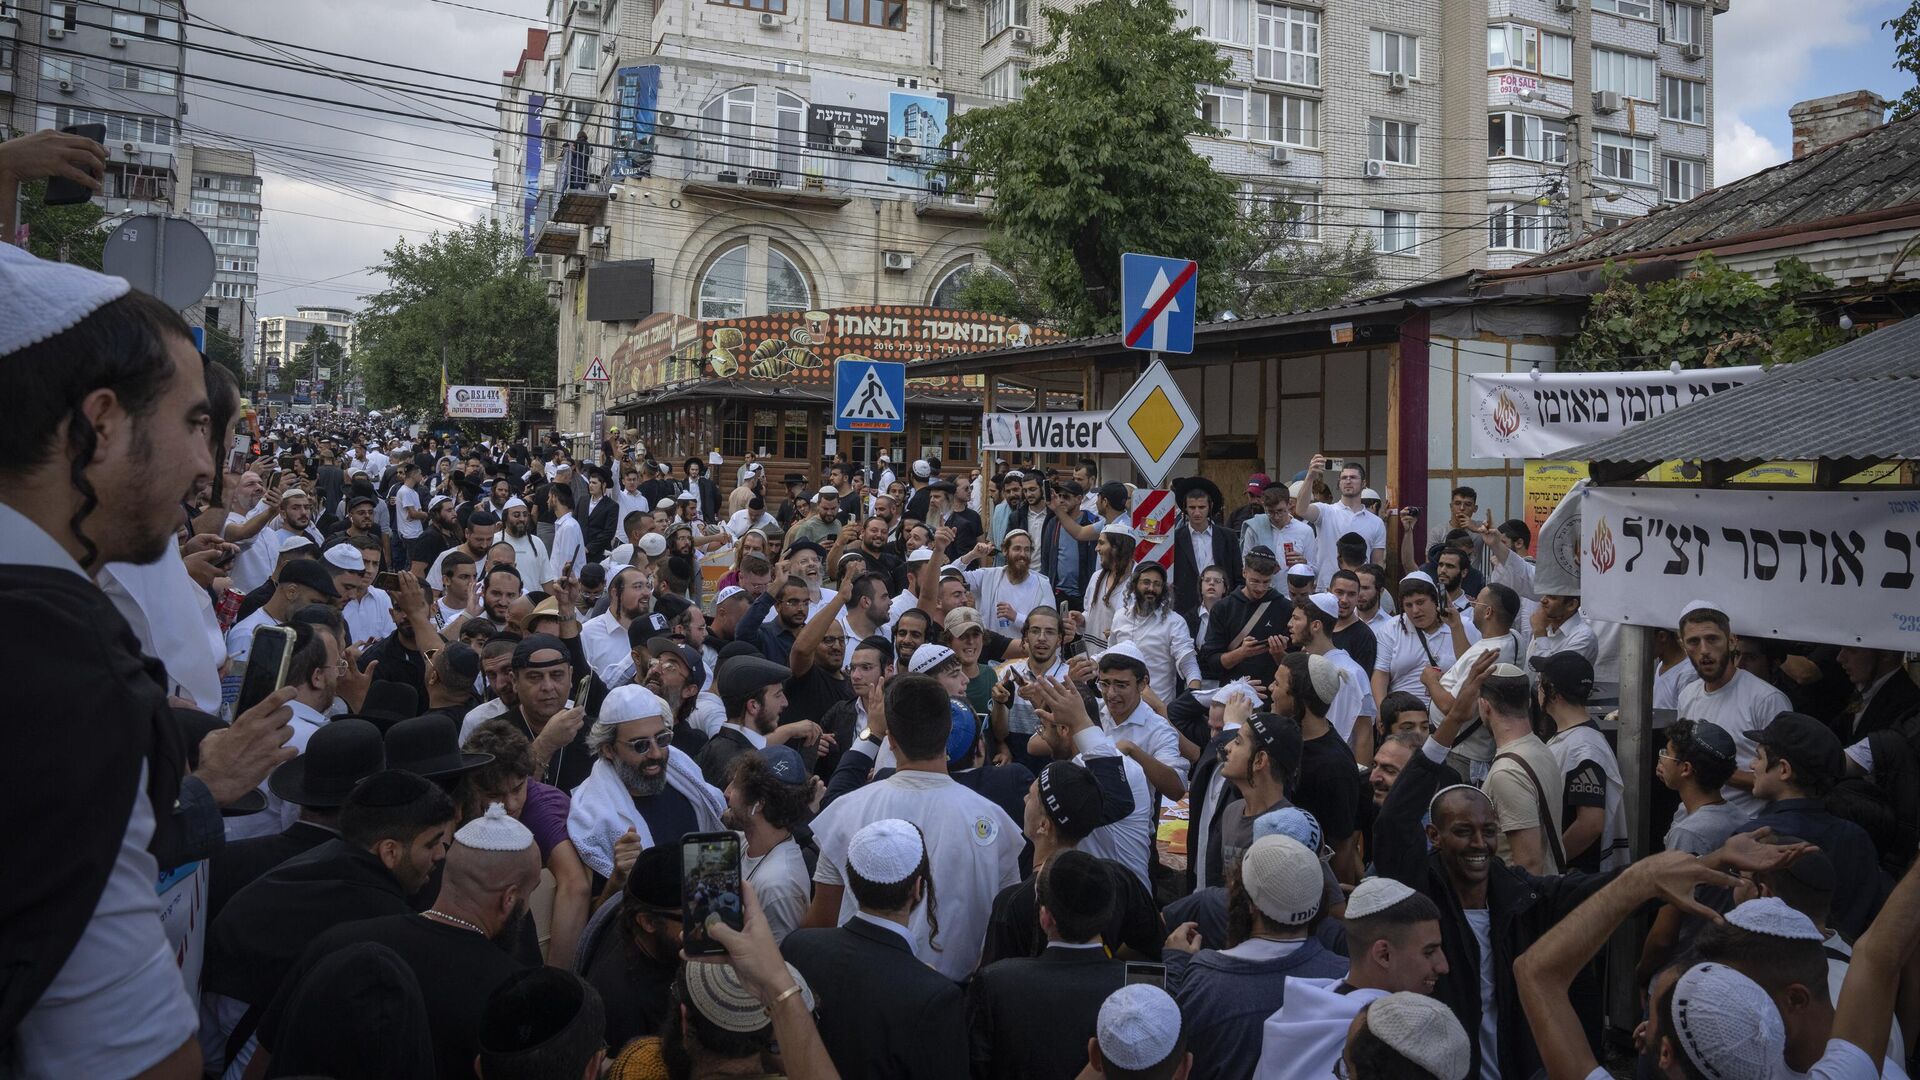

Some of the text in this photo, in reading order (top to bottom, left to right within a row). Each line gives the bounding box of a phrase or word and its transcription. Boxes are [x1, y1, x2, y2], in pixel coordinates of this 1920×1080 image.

[1500, 76, 1536, 89] FOR SALE
[815, 108, 886, 126] ישוב הדעת
[833, 313, 1004, 344] המאפה הנאמן
[873, 342, 894, 351] 2016
[898, 344, 932, 353] בשנת
[486, 389, 500, 400] 4X4
[1533, 387, 1609, 427] מאומן
[1615, 384, 1678, 426] נחמן
[1027, 416, 1103, 448] Water
[1529, 492, 1551, 503] צדקה
[1887, 500, 1920, 514] אומן
[1623, 515, 1920, 590] ב אודסר זצ״ל
[1569, 783, 1605, 796] adidas
[1046, 794, 1060, 812] נח
